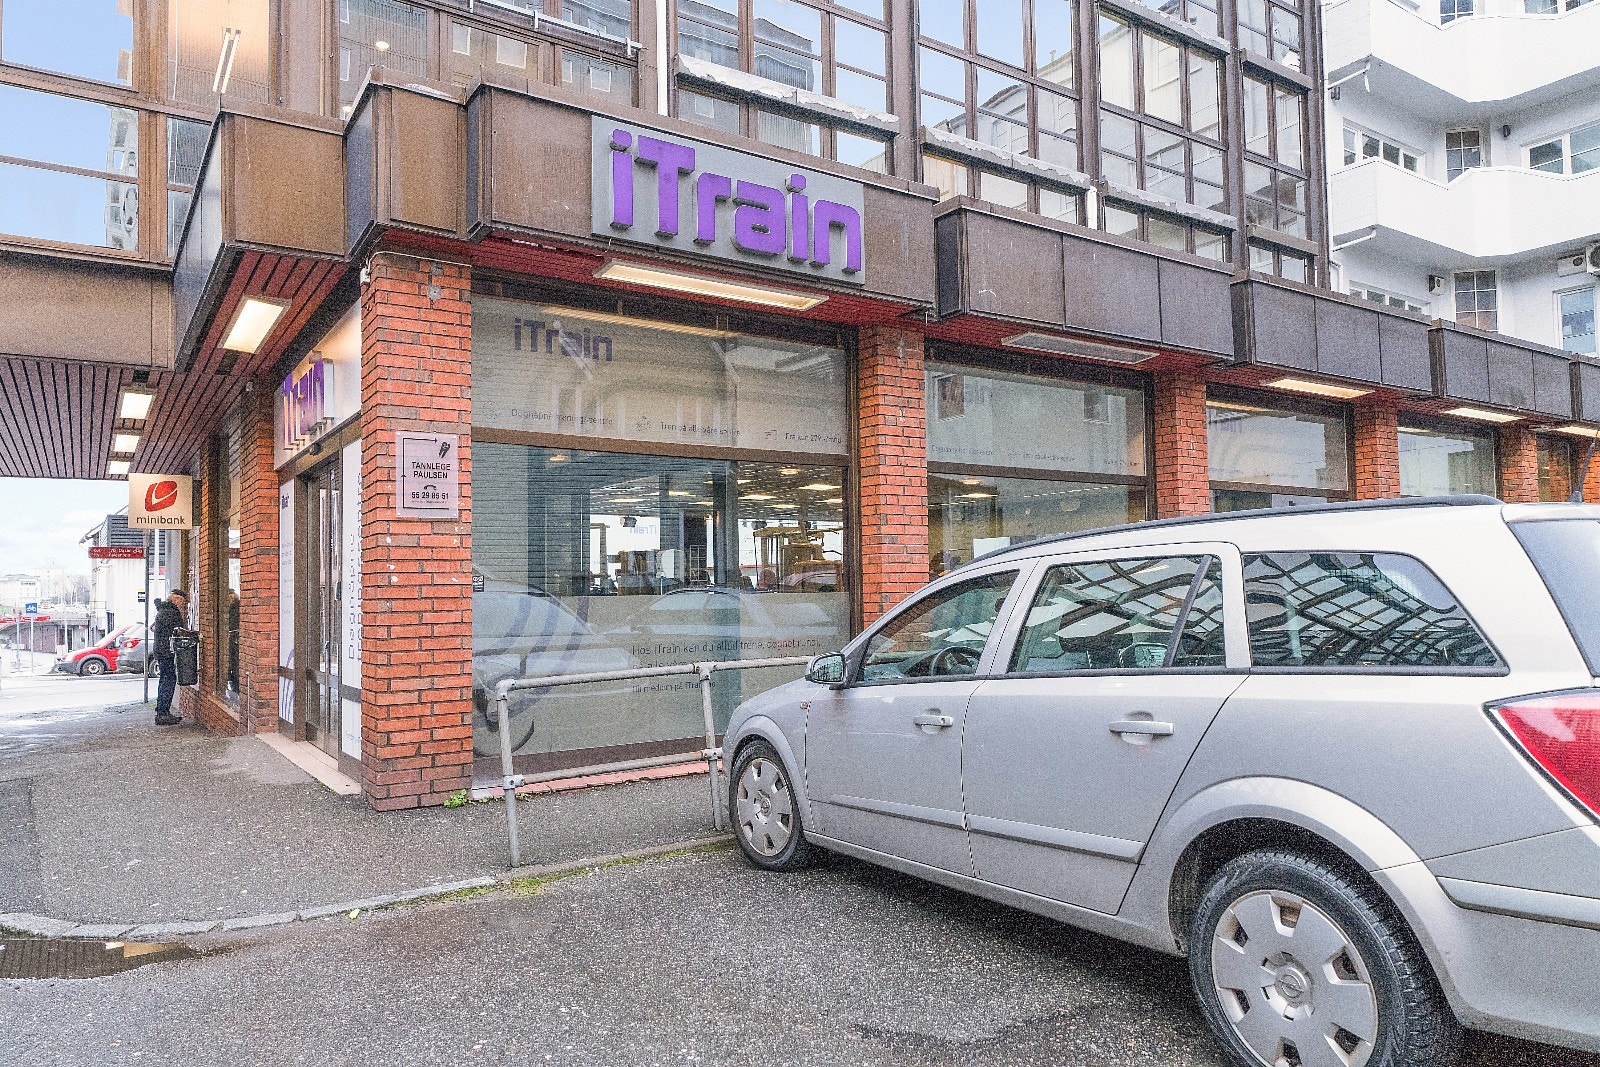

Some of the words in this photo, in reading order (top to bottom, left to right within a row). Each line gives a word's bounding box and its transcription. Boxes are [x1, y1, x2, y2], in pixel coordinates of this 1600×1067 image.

[609, 128, 862, 272] iTrain
[514, 317, 613, 361] iTrain
[411, 461, 451, 471] TANNLEGE
[413, 470, 448, 479] PAULSEN
[411, 491, 420, 499] 55
[421, 491, 430, 500] 29
[441, 492, 449, 500] 51
[136, 515, 186, 526] minibank
